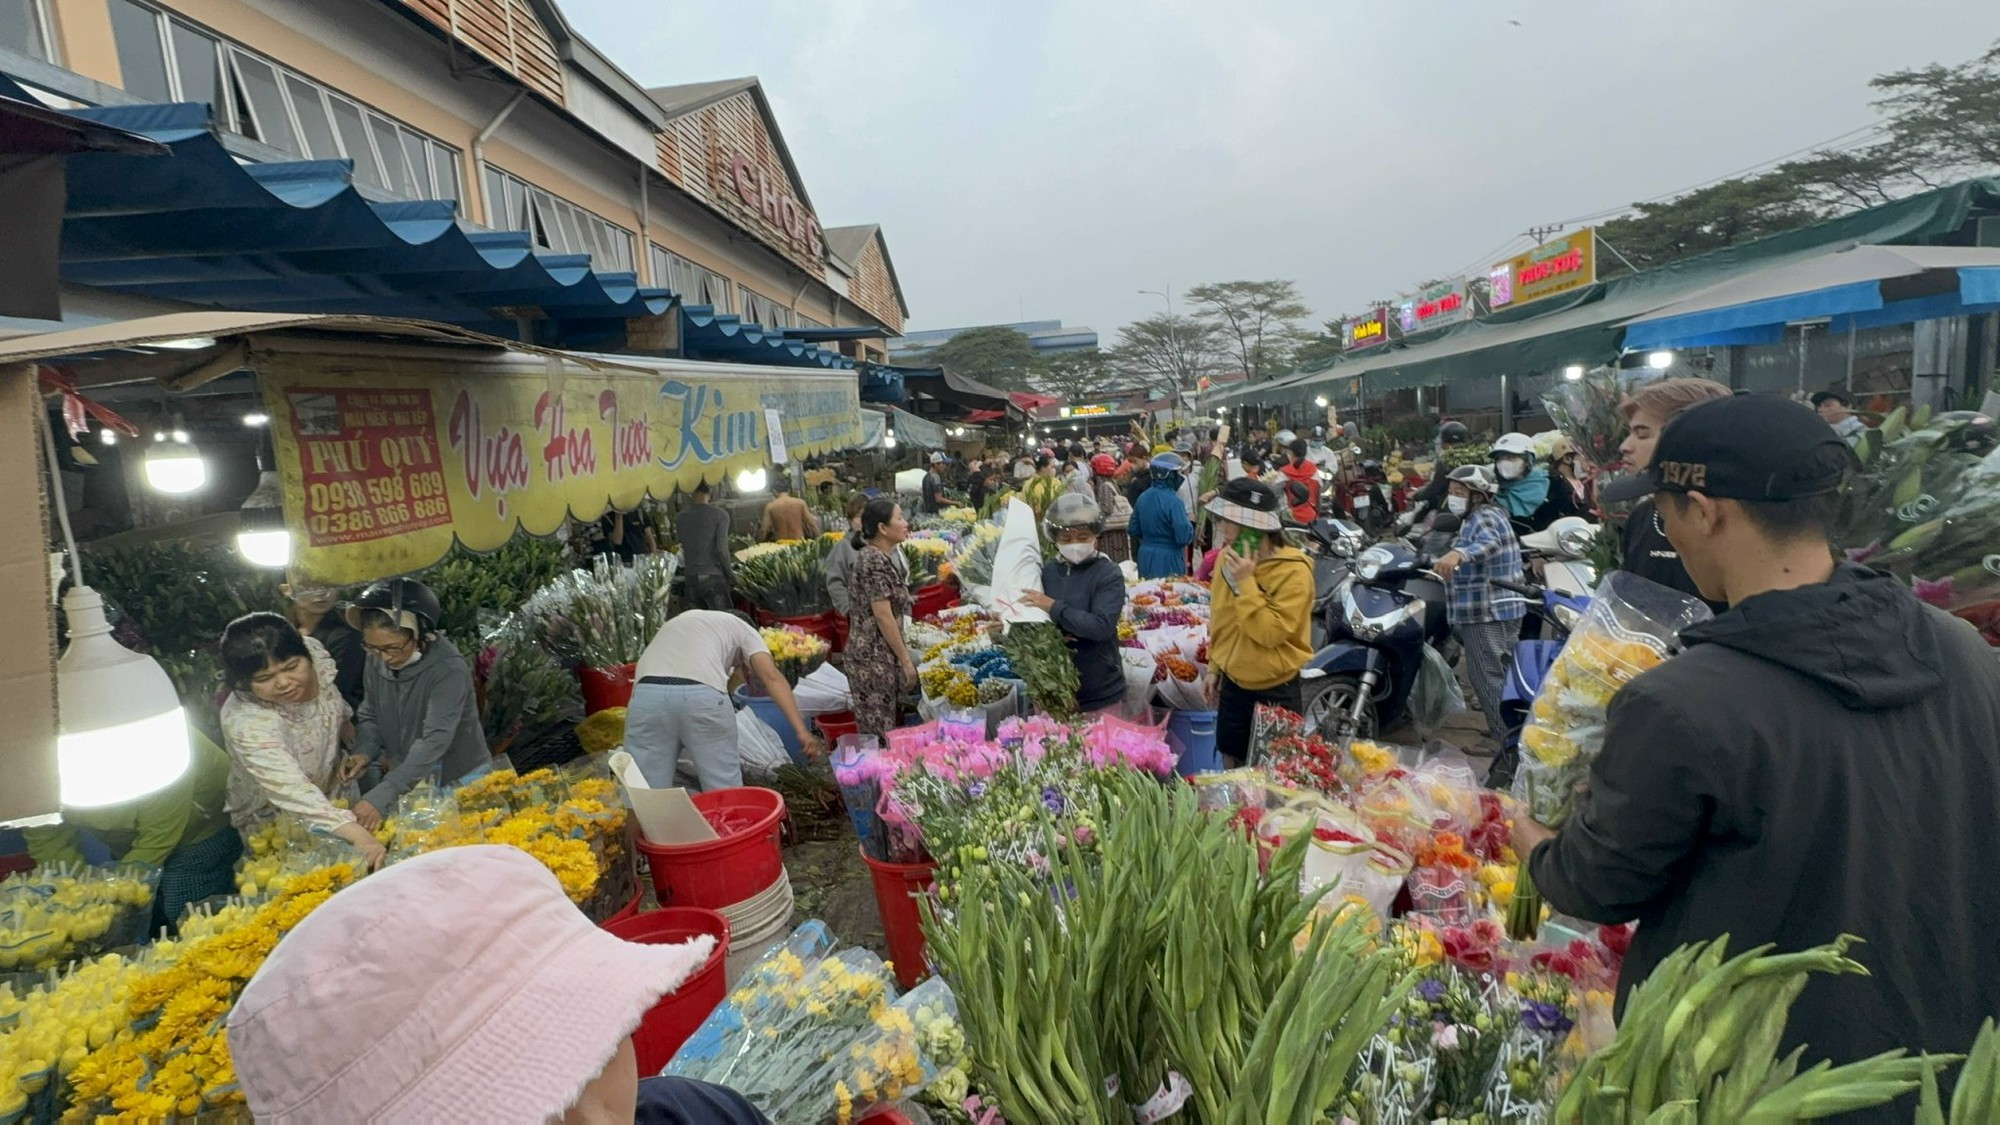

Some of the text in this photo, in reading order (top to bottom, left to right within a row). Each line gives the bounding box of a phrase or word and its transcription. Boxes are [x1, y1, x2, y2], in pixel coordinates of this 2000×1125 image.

[307, 426, 433, 477] PHÚ QUÝ
[449, 379, 759, 517] Vựa Hoa Tươi Kim
[310, 471, 444, 513] 0938 598 689
[1659, 460, 1707, 488] 1972
[310, 497, 448, 535] 0386 866 886
